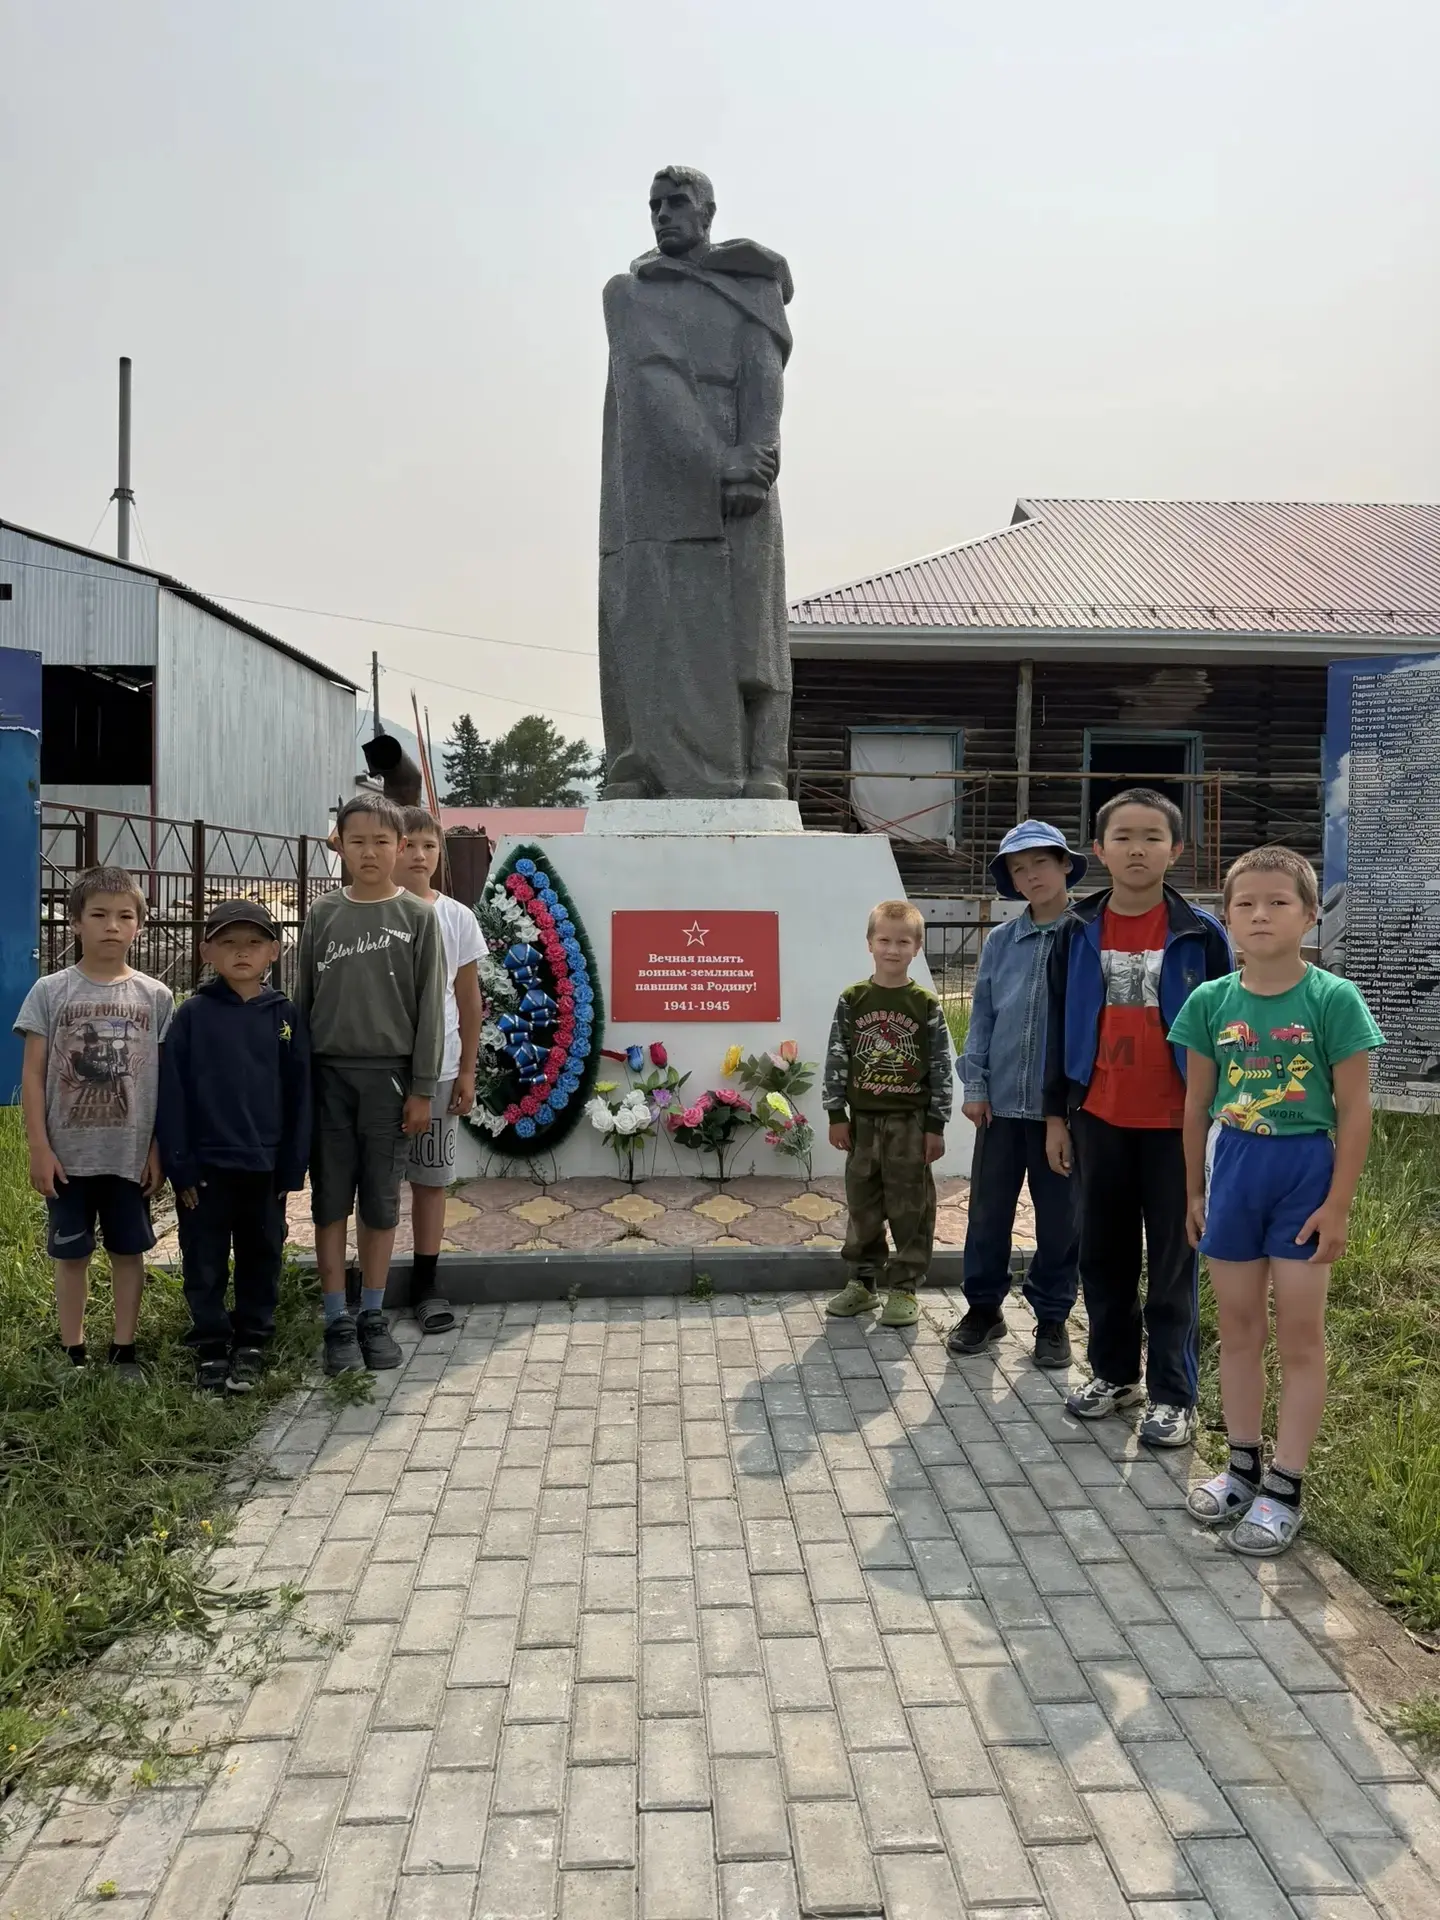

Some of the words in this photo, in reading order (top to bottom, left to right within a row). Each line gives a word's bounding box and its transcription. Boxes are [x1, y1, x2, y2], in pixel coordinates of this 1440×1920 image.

[356, 931, 391, 954] World
[648, 953, 695, 964] Вечная
[697, 955, 744, 964] память
[638, 969, 755, 978] воинам-землякам
[635, 982, 688, 992] павшим
[690, 983, 705, 992] за
[706, 981, 757, 994] Родину!
[663, 1000, 731, 1011] 1941-1945
[1268, 1107, 1305, 1120] WORK
